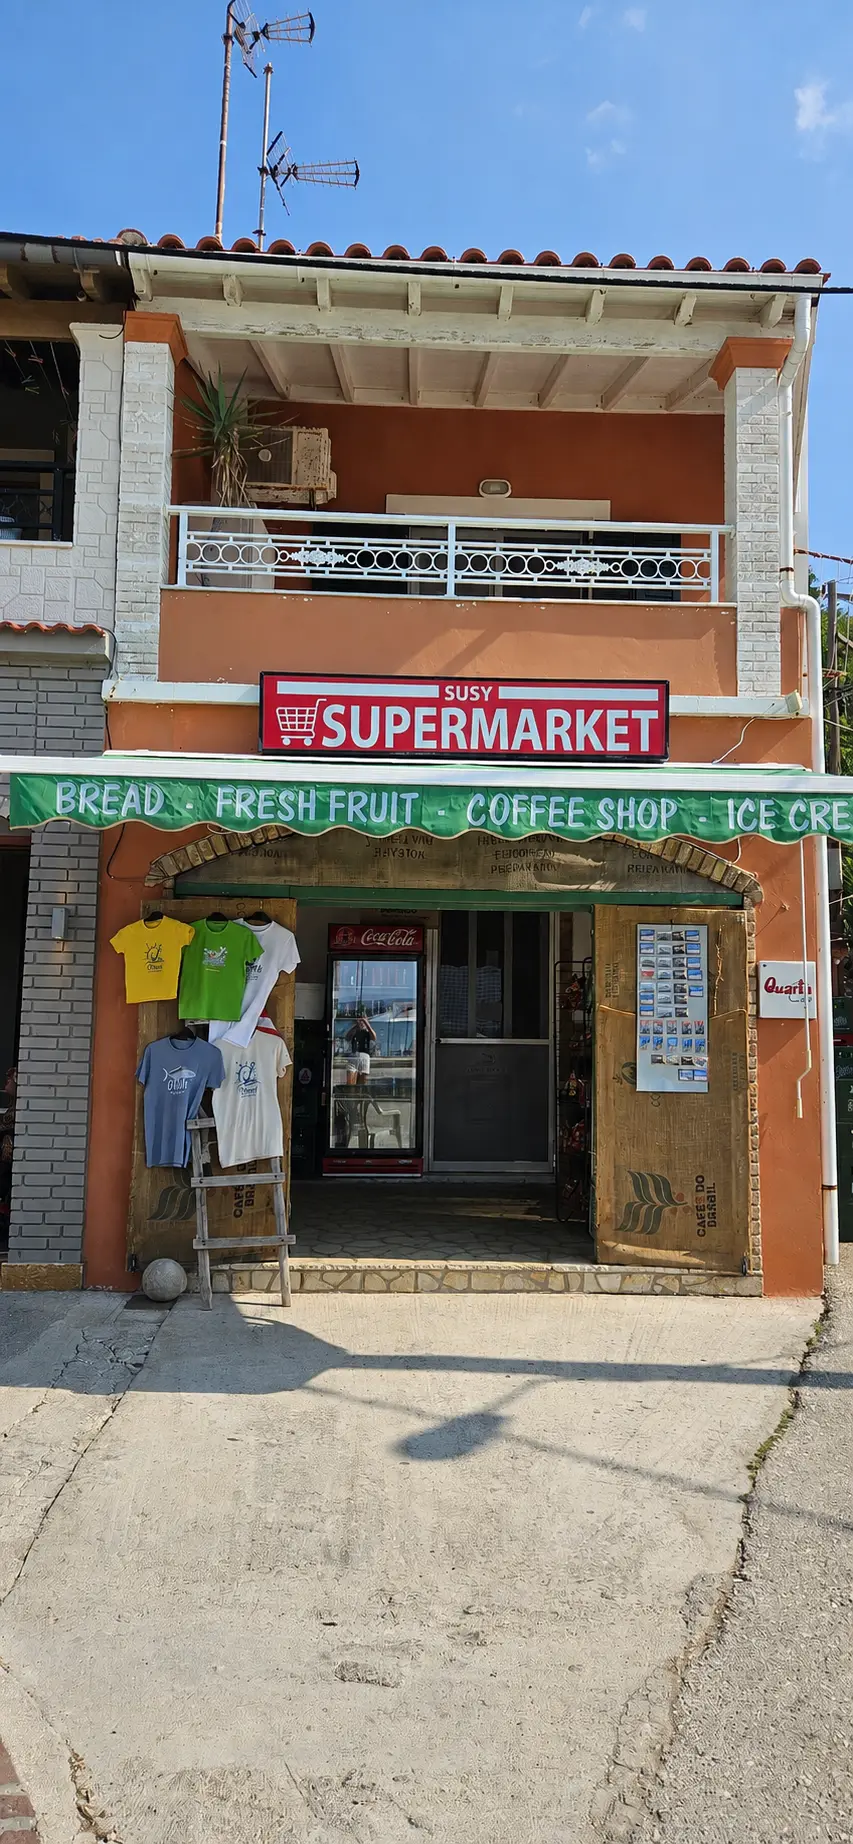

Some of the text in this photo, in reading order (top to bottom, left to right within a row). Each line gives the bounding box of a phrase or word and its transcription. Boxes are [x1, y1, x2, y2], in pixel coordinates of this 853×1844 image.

[445, 685, 494, 702] SUSY
[321, 704, 659, 752] SUPERMARKET
[55, 781, 165, 817] BREAD
[215, 784, 317, 822] FRESH
[328, 790, 420, 825] FRUIT
[466, 792, 585, 829] COFFEE
[596, 795, 679, 832] SHOP
[726, 797, 776, 831] ICE
